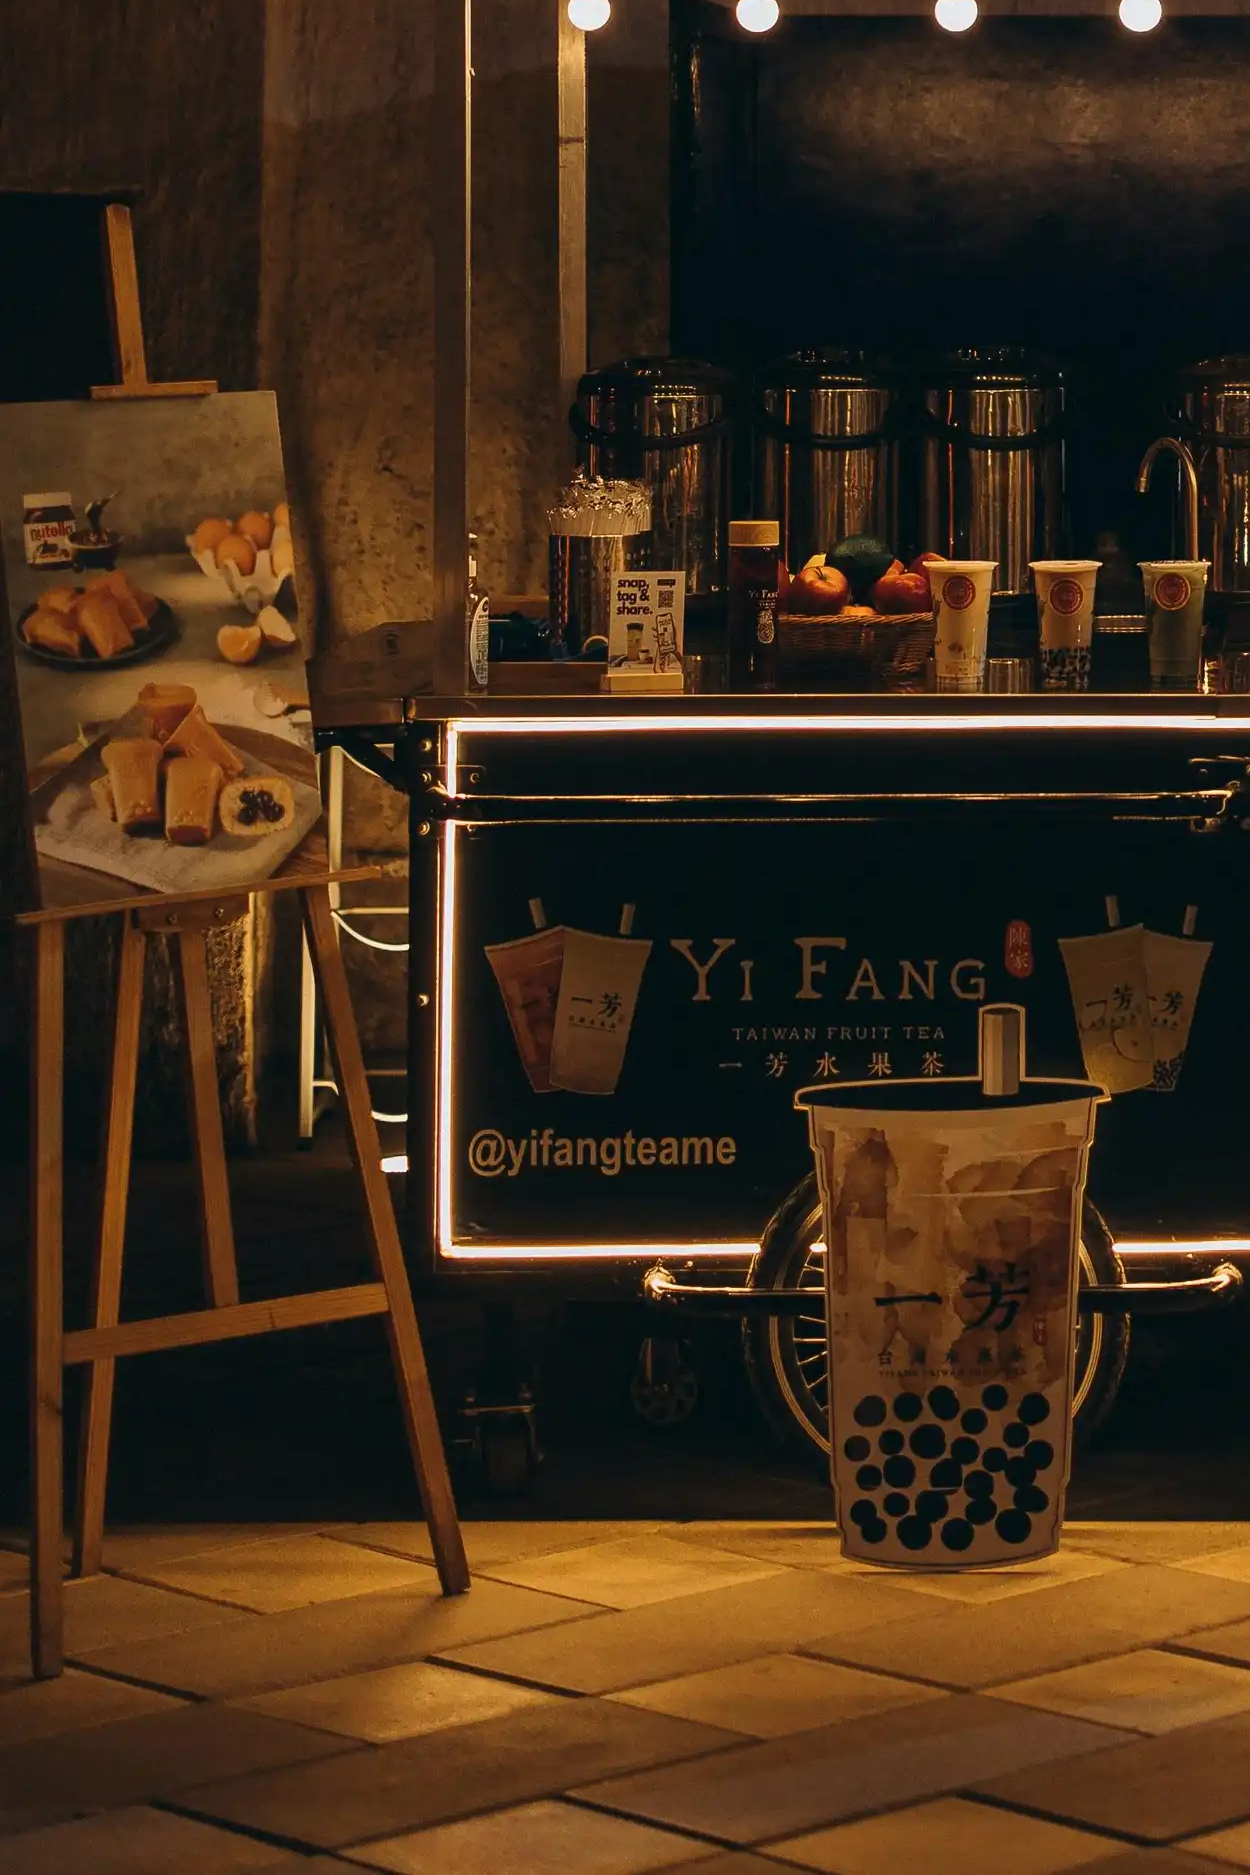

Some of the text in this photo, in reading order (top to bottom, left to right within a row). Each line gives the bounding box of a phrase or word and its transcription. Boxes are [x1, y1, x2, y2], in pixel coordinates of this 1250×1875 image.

[616, 588, 651, 605] tag &
[617, 579, 650, 591] snap,
[616, 602, 653, 615] share.
[670, 937, 985, 1000] YI FANG
[571, 991, 622, 1018] 一芳
[732, 1027, 945, 1041] TAIWAN FRUIT TEA
[719, 1053, 944, 1076] 一芳水果茶
[468, 1127, 737, 1177] @yifangteame
[873, 1261, 1030, 1333] 一芳
